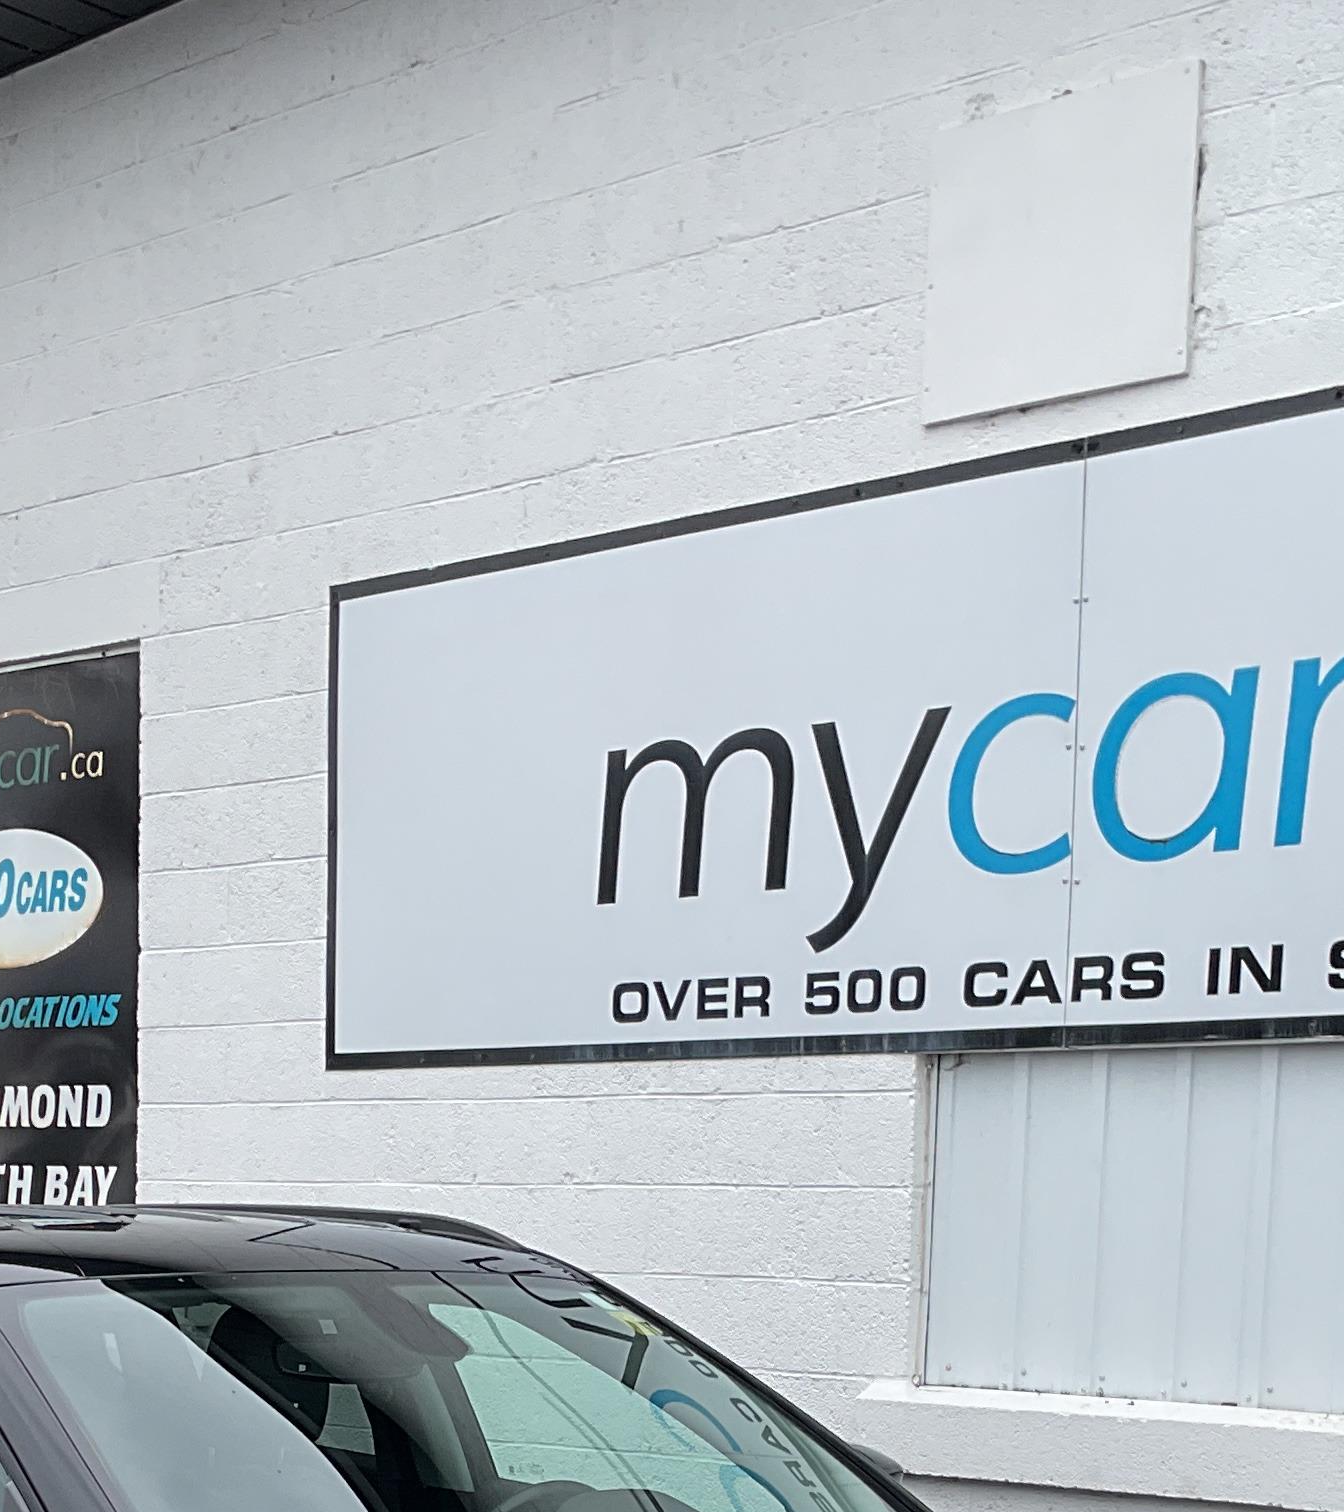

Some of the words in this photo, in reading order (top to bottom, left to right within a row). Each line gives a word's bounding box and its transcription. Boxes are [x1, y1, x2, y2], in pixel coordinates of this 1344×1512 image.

[612, 976, 772, 1024] OVER
[805, 966, 927, 1015] 500
[962, 950, 1166, 1006] CARS
[1207, 943, 1284, 996] IN
[44, 1165, 118, 1206] BAY
